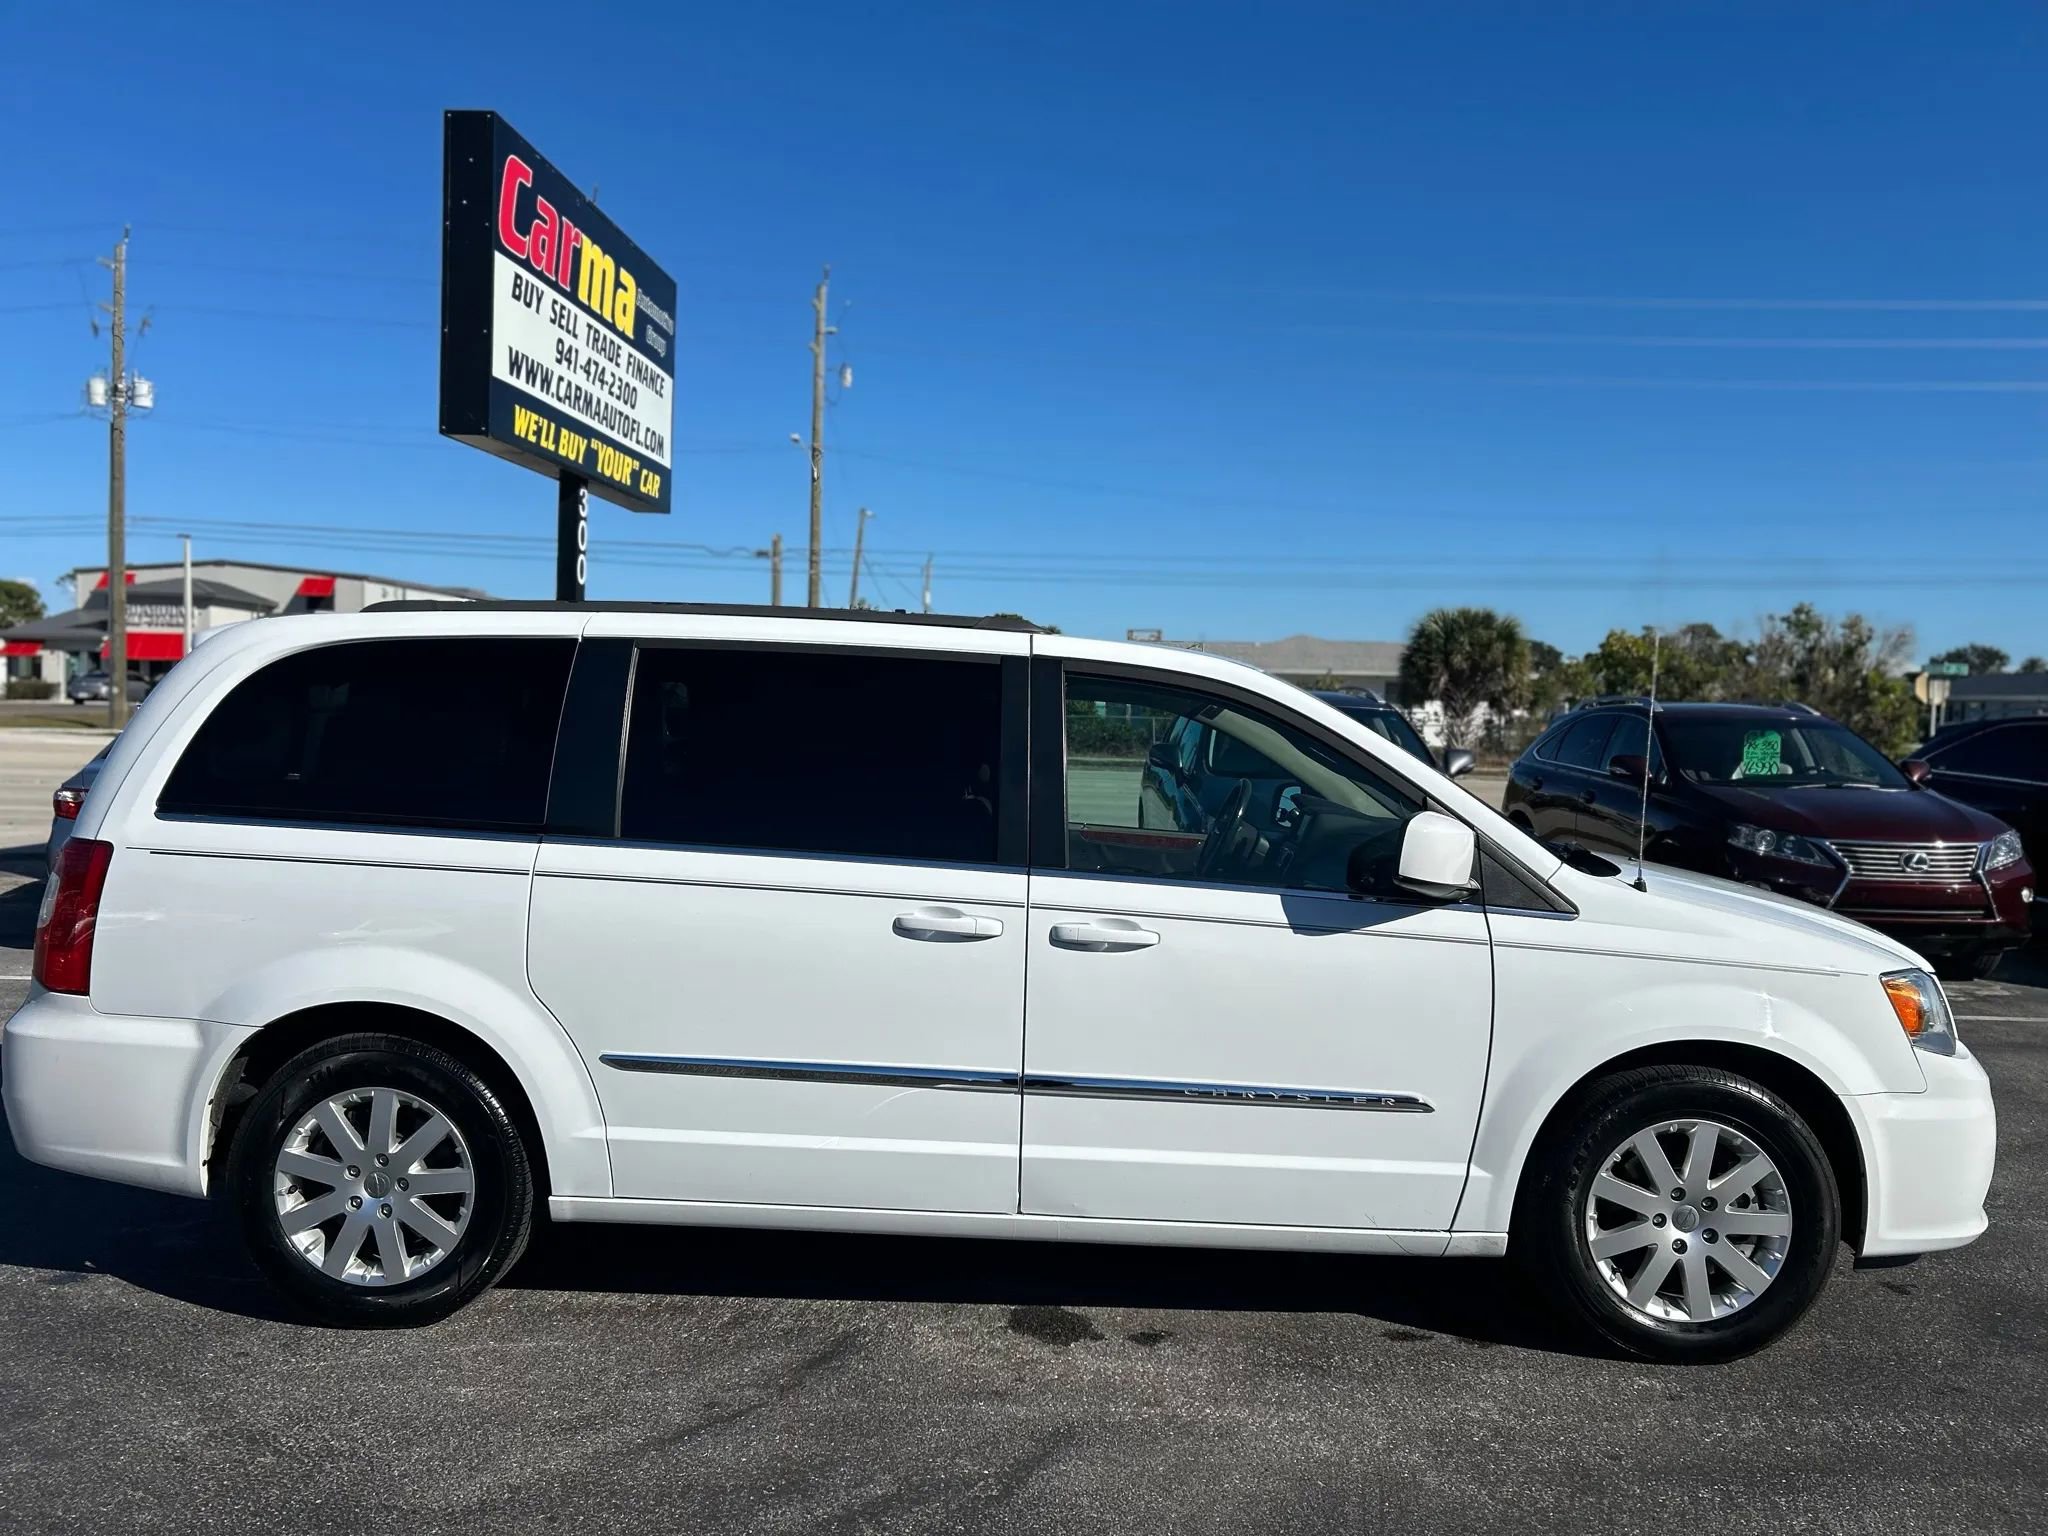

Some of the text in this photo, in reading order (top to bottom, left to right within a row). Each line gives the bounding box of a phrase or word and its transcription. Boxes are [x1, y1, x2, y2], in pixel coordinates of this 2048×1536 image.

[499, 154, 637, 340] Carma
[511, 271, 665, 399] BUY SELL TRADE FINANCE
[555, 337, 638, 410] 941-474-2300
[508, 345, 665, 459] WWW.CARMAAUTOFL.COM
[514, 404, 556, 452] WE'LL
[558, 427, 588, 465] BUY
[639, 468, 661, 499] CAR
[577, 487, 589, 586] 300
[1184, 1087, 1396, 1106] CHRYSLER
